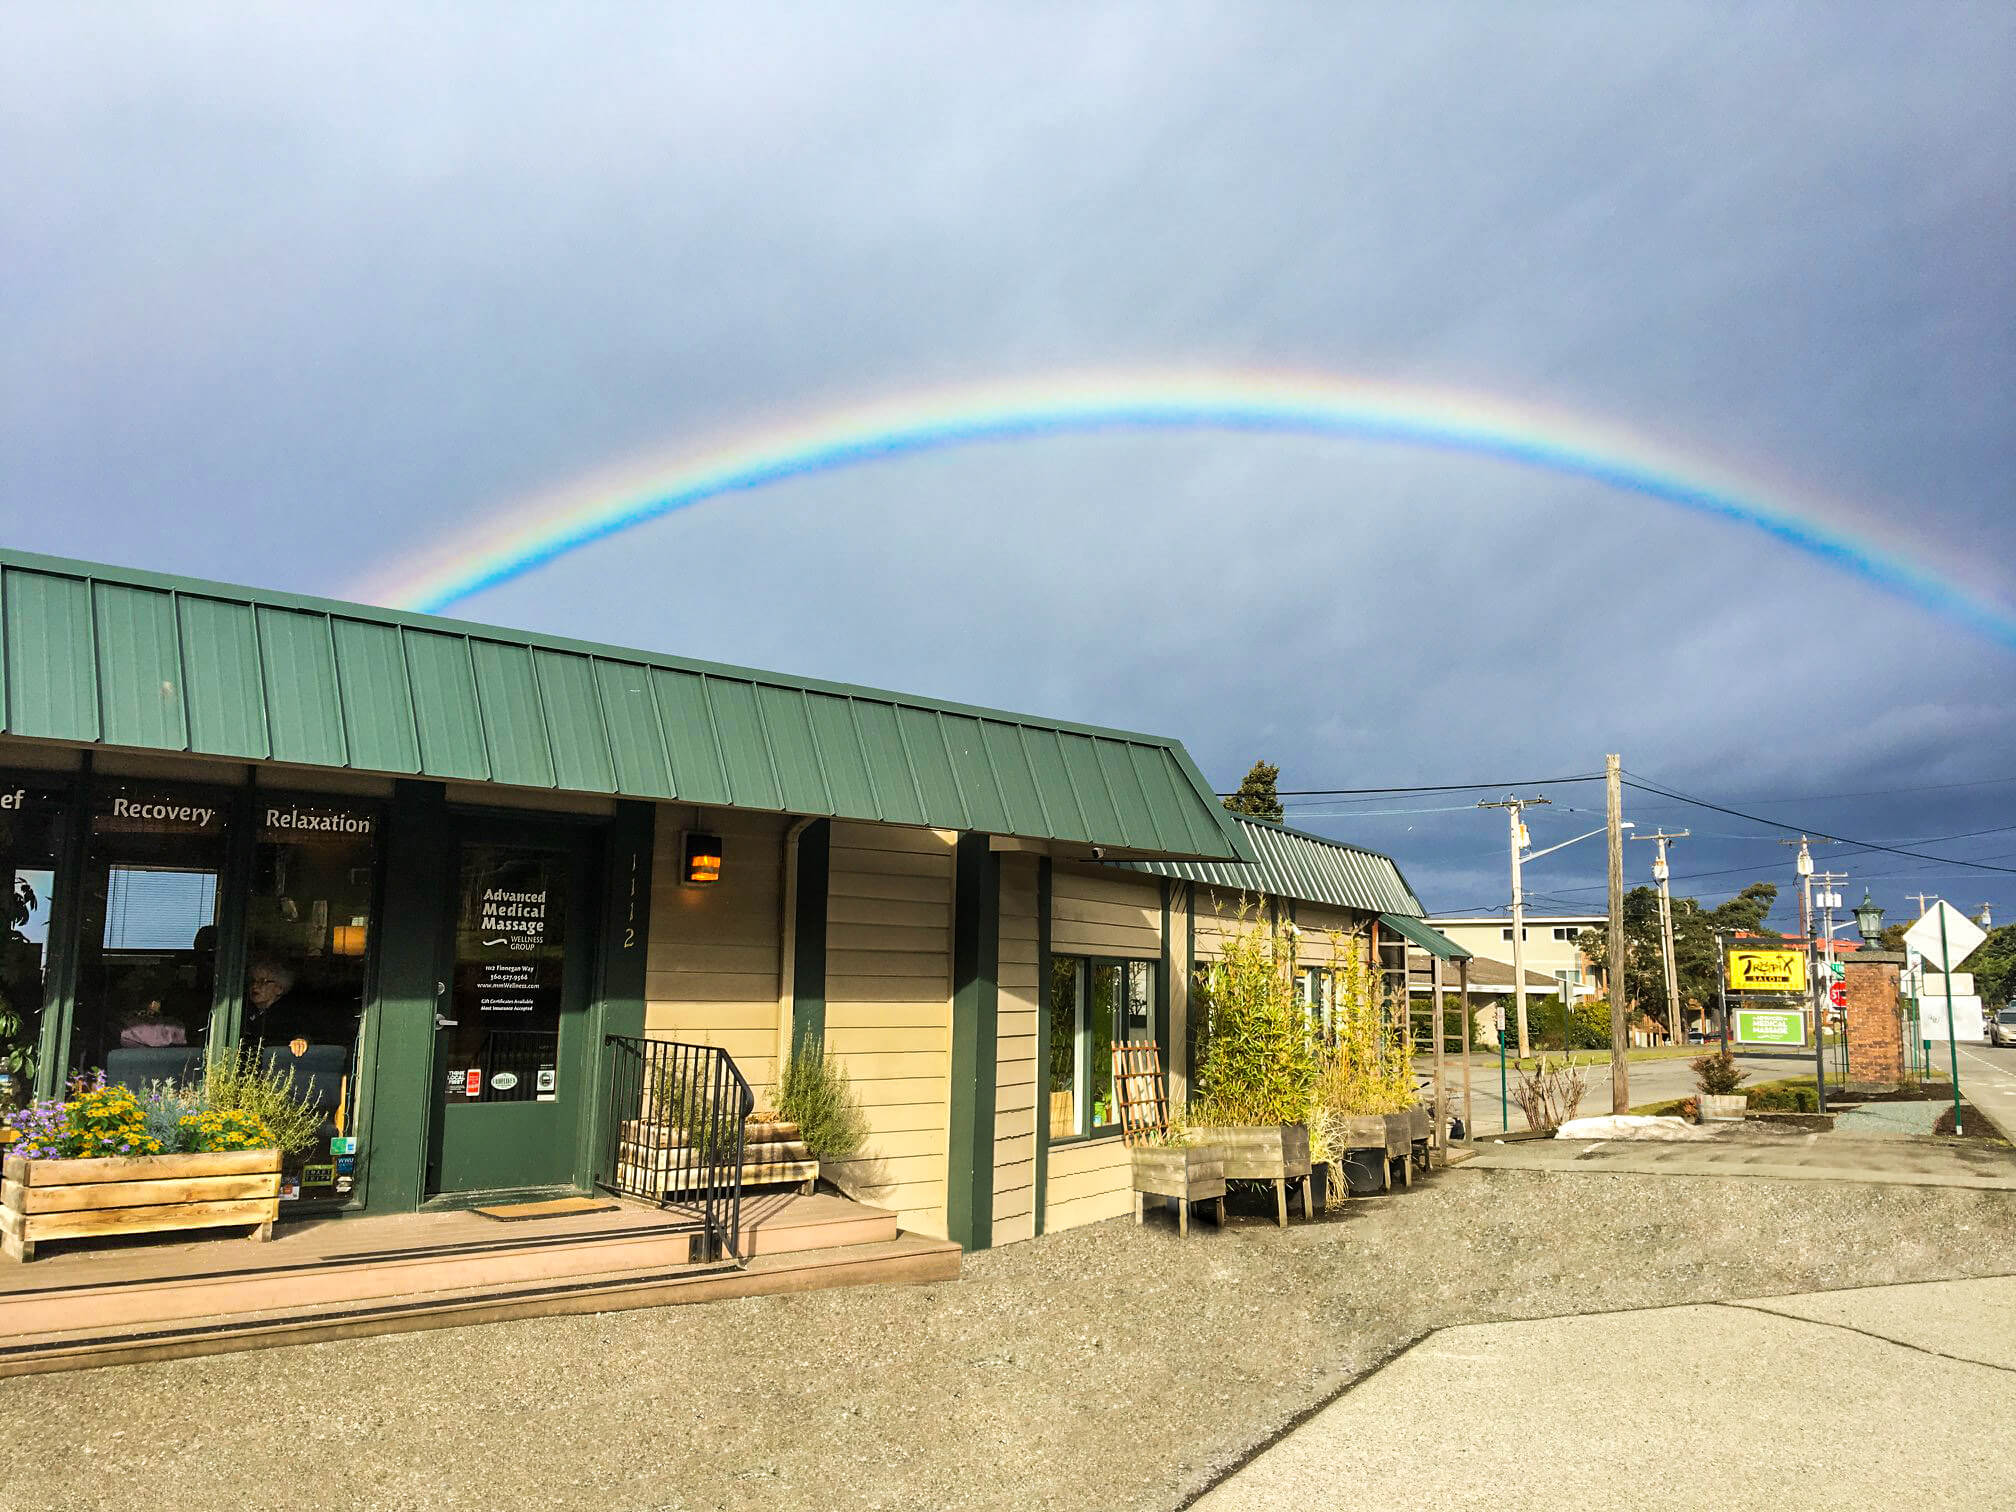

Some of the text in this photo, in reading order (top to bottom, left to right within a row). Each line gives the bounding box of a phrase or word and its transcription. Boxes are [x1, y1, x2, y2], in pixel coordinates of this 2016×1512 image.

[113, 798, 213, 827] Recovery
[266, 809, 371, 833] Relaxation
[483, 888, 546, 903] Advanced
[623, 853, 636, 948] 1112
[482, 902, 545, 918] Medical
[481, 917, 544, 935] Massage
[510, 943, 535, 951] GROUP
[496, 965, 521, 973] Finnegan
[521, 965, 535, 973] Way
